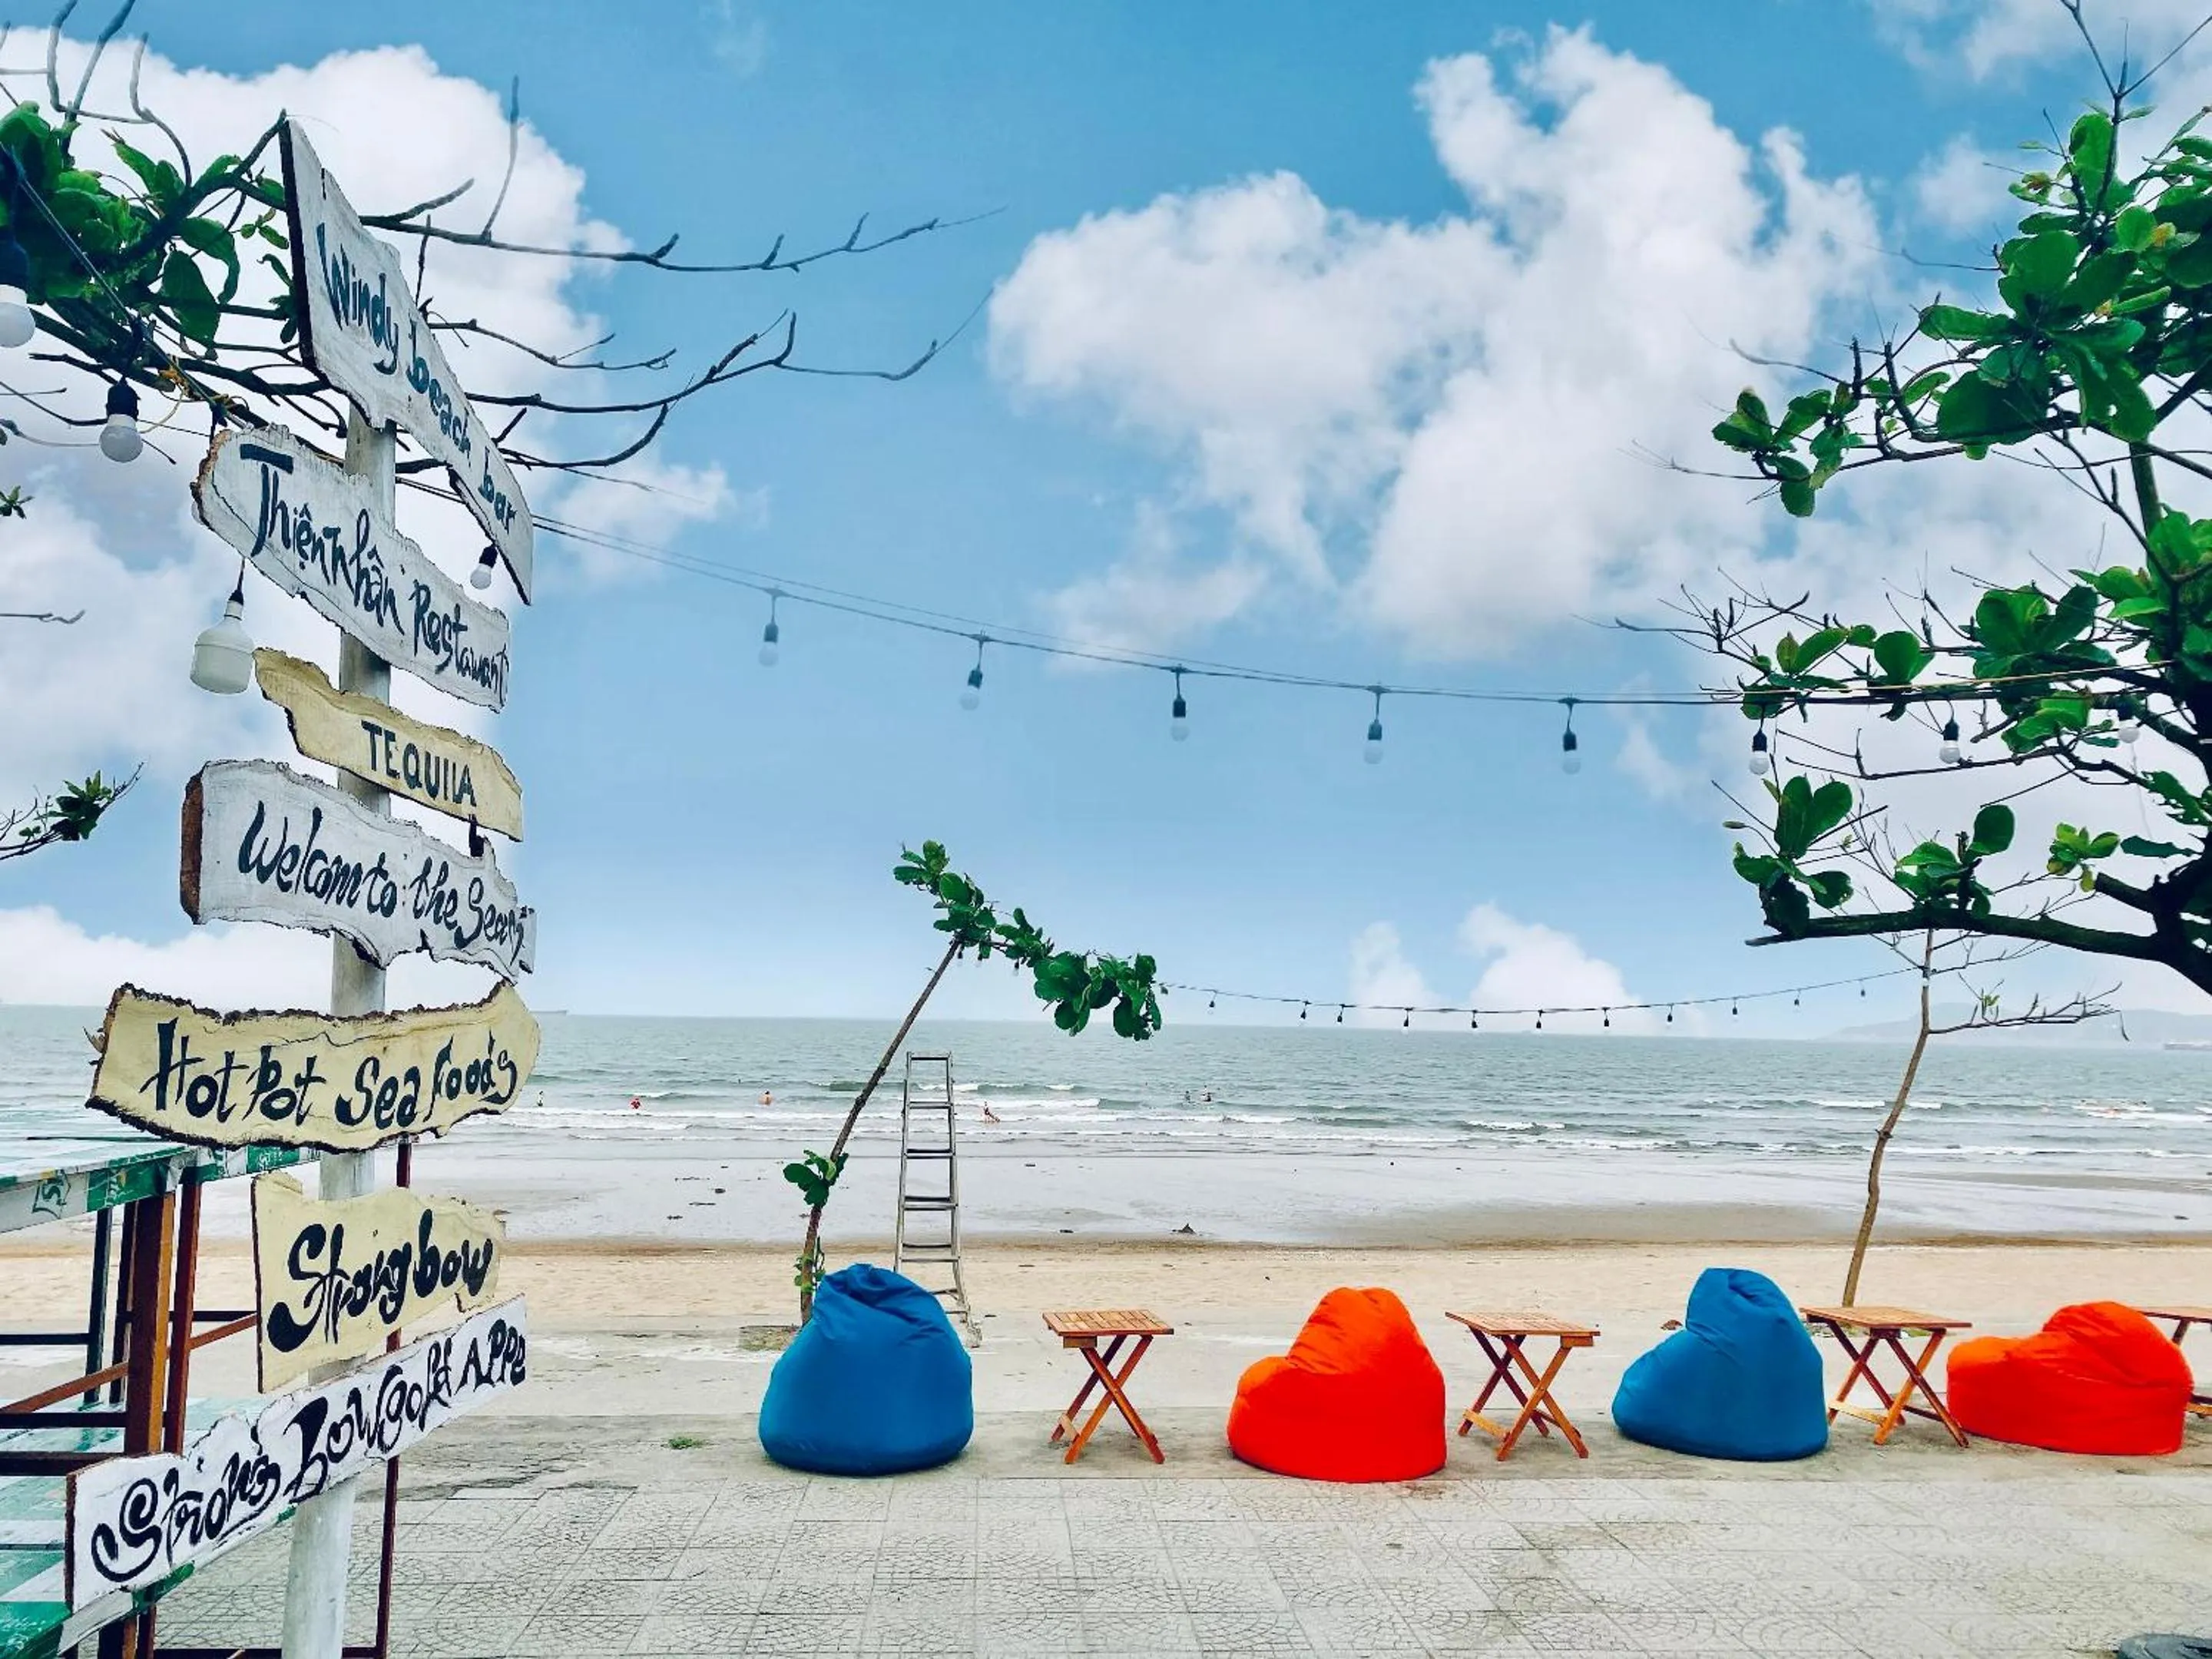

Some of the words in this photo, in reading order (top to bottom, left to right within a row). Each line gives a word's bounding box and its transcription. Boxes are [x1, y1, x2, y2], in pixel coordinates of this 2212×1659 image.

[316, 223, 399, 375] Windy
[406, 315, 472, 467] beach
[478, 446, 517, 535] bar
[361, 720, 477, 807] TEQUILA
[409, 856, 459, 931] the
[138, 1017, 250, 1123] Hot
[334, 1055, 421, 1130] Sea
